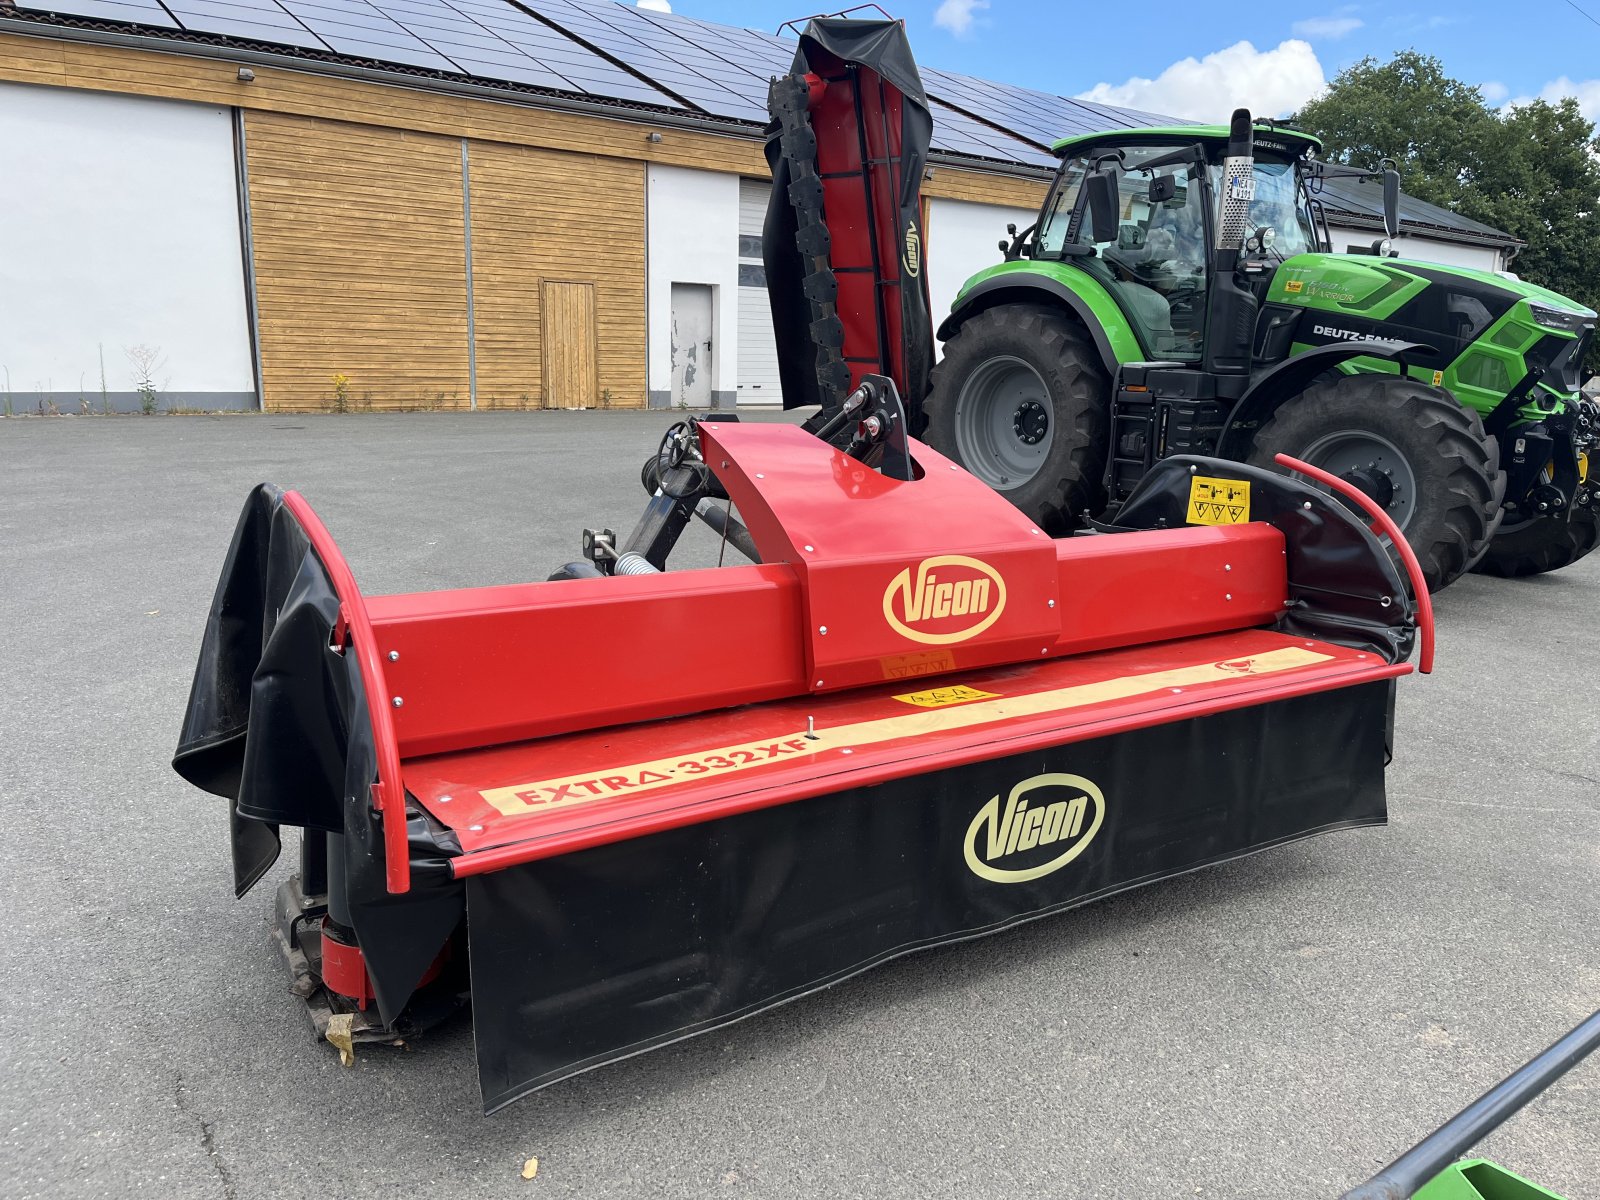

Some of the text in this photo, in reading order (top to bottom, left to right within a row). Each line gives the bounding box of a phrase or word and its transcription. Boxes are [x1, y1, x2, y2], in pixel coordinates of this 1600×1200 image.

[905, 221, 919, 269] Vicon
[1306, 286, 1354, 301] WARRIOR
[1313, 325, 1405, 342] DEUTZ-FA
[901, 557, 991, 623] Vicon
[984, 781, 1090, 861] Vicon
